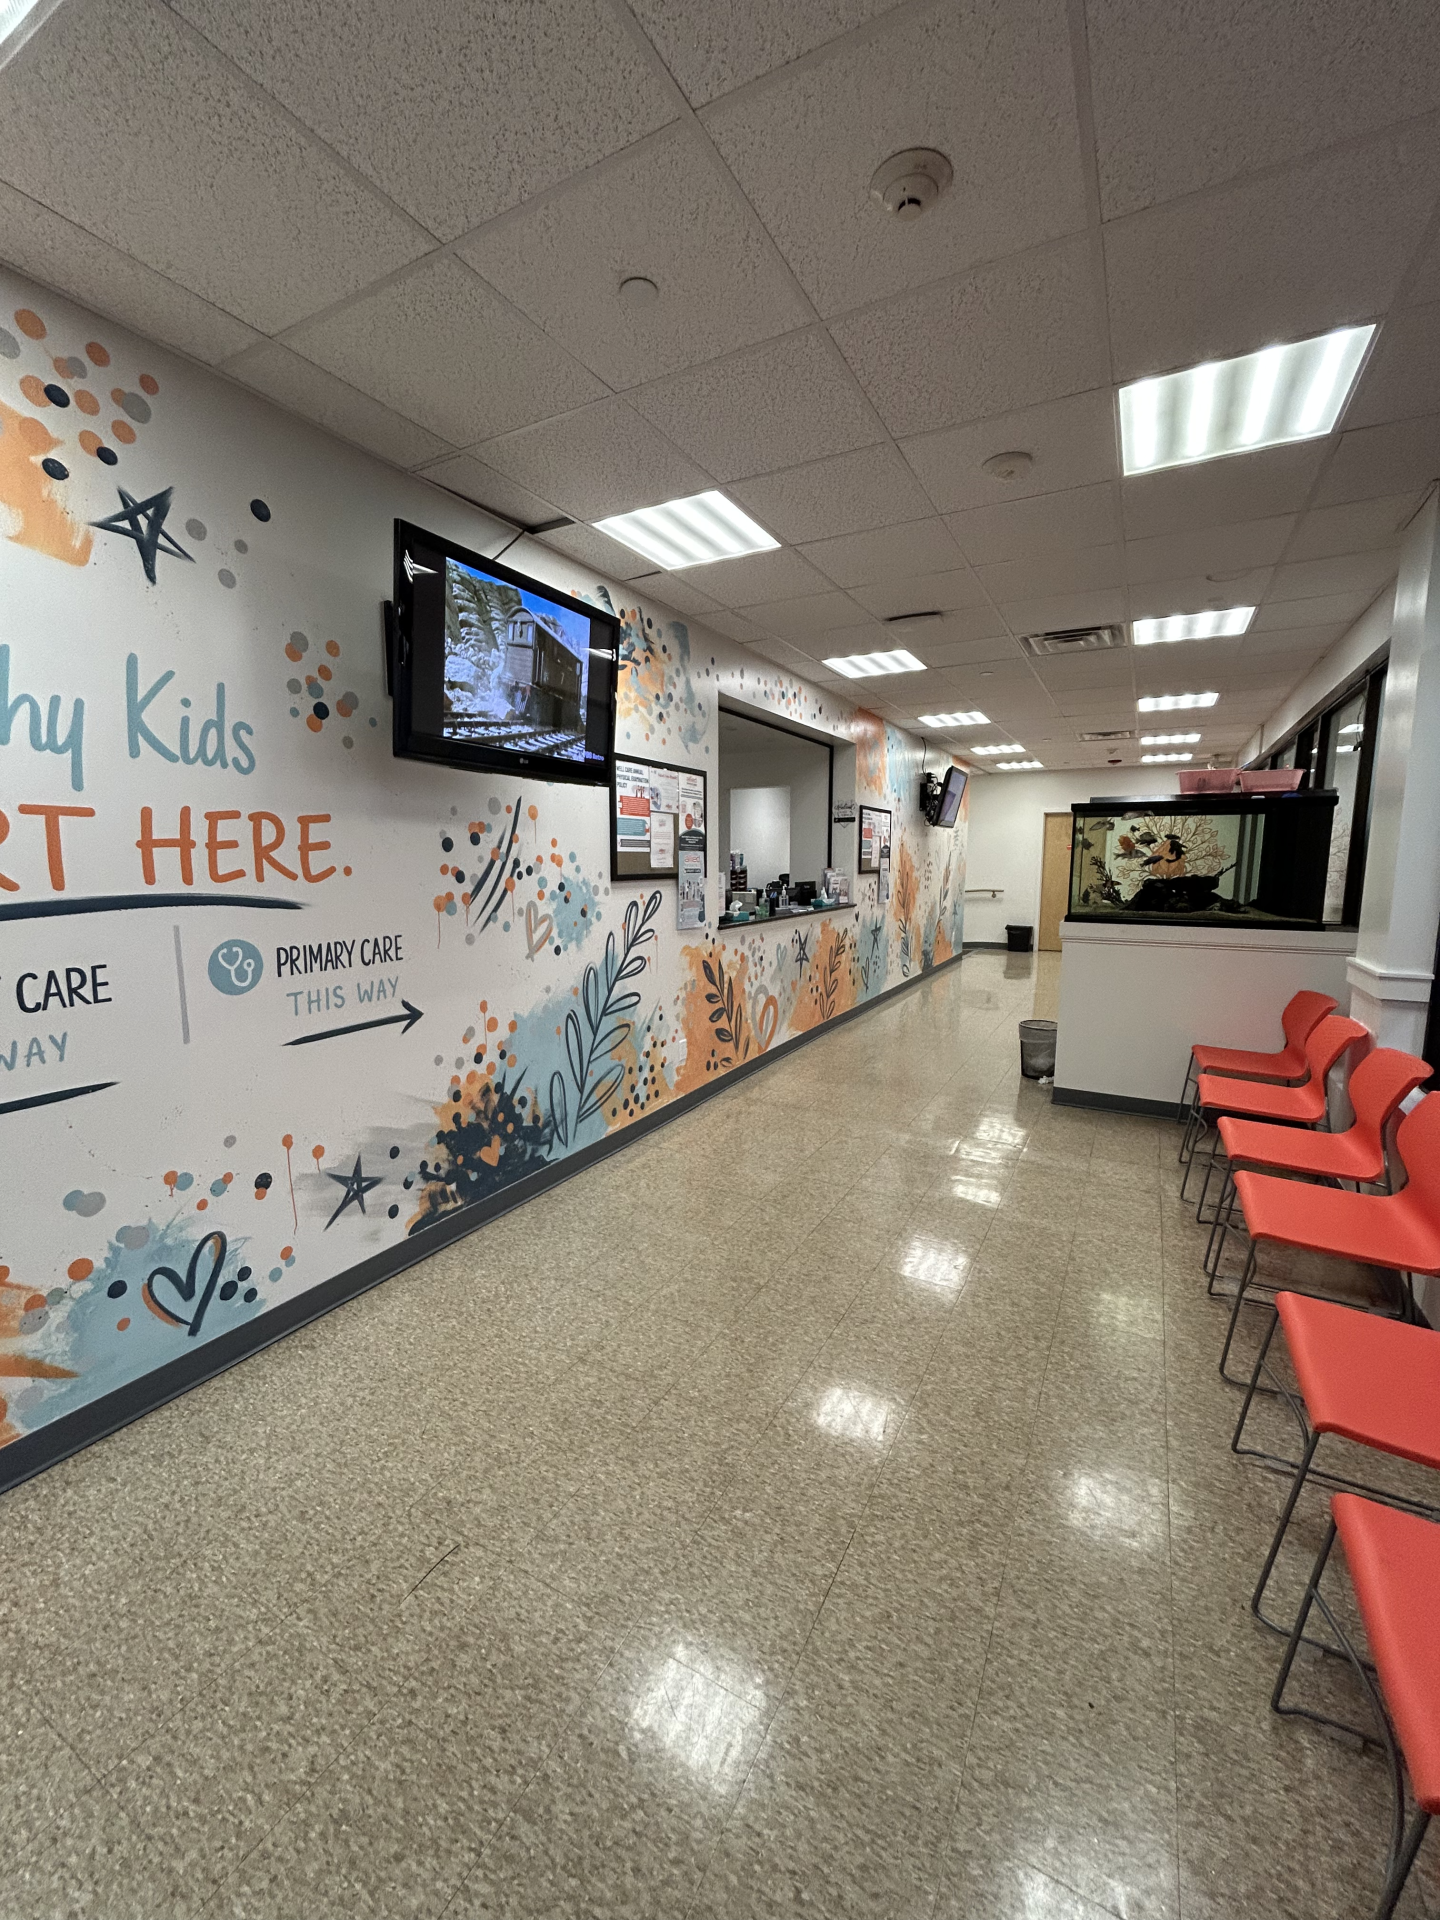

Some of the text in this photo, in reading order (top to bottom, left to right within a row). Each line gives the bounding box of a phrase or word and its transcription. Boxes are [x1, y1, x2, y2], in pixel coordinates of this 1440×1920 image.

[126, 653, 256, 775] Kids
[136, 806, 352, 886] HERE.
[276, 935, 404, 977] PRIMARY CARE
[16, 964, 113, 1014] CARE
[286, 976, 399, 1016] THIS WAY
